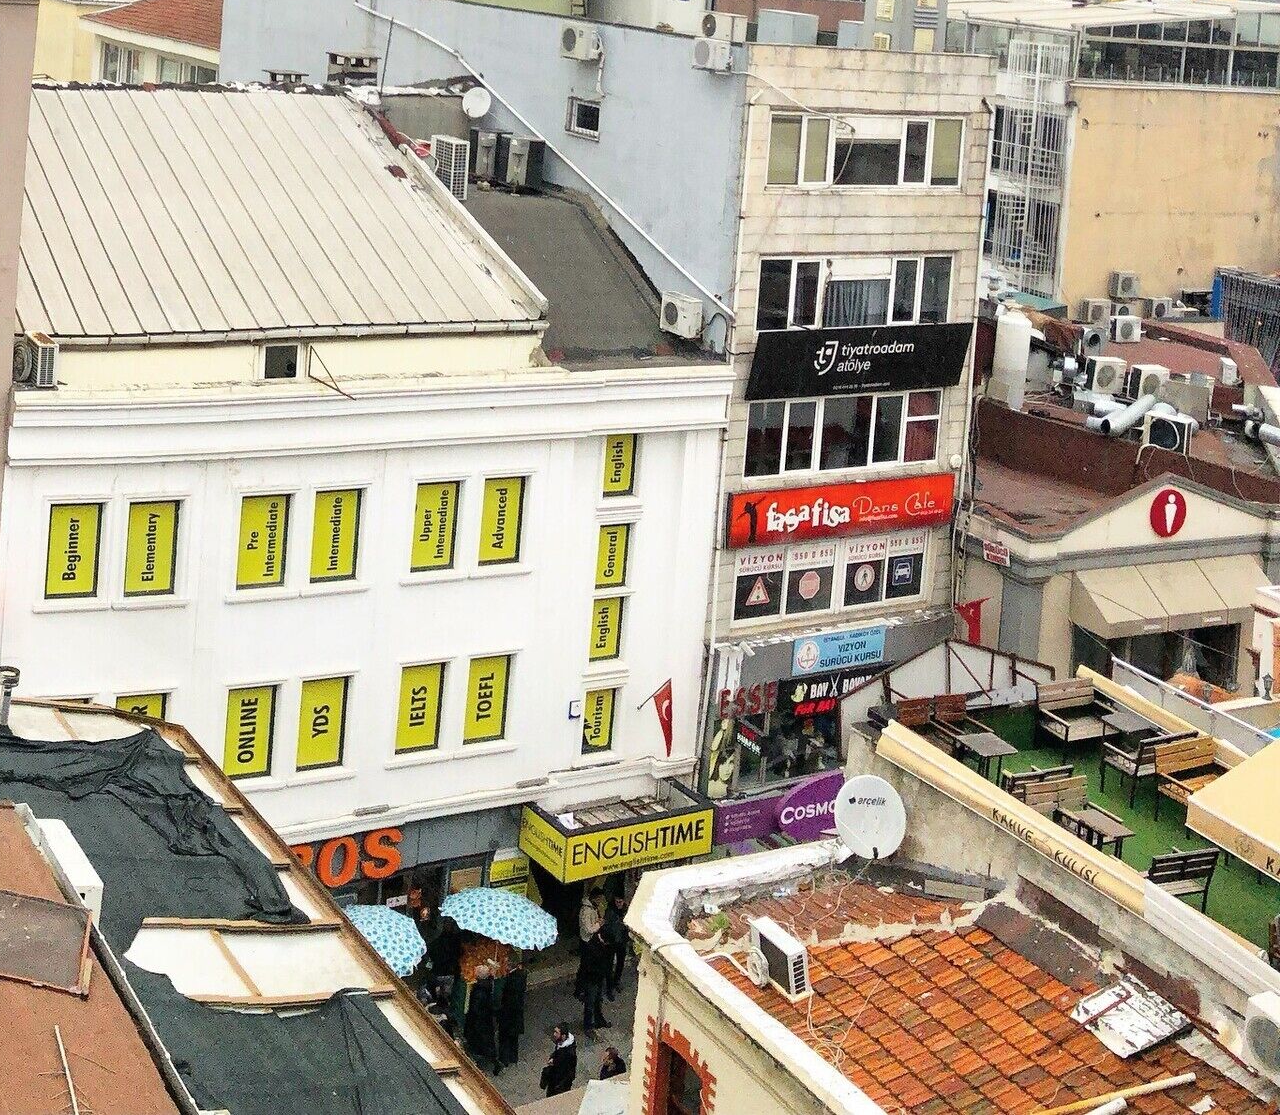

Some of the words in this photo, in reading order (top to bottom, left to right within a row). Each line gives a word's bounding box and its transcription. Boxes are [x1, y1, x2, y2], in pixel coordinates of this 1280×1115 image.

[836, 359, 871, 374] atölye
[841, 339, 915, 357] tiyatroadam
[610, 441, 625, 484] English
[420, 508, 433, 542] Upper
[433, 489, 450, 559] Intermediate
[491, 487, 509, 549] Advanced
[852, 495, 899, 515] Dans
[904, 491, 936, 516] Cafe
[61, 517, 81, 581] Beginner
[141, 512, 161, 582] Elementary
[246, 531, 260, 551] Pre
[262, 501, 279, 577] Intermediate
[326, 496, 343, 571] Intermediate
[603, 530, 618, 578] General
[596, 606, 611, 649] English
[854, 649, 882, 663] KURSU
[409, 685, 428, 727] IELTS
[476, 672, 495, 723] TOEFL
[590, 695, 604, 741] Tourism
[236, 696, 259, 764] ONLINE
[311, 704, 330, 738] YDS
[857, 795, 887, 807] arçelik
[571, 818, 705, 866] ENGLISHTIME
[992, 807, 1034, 843] KAHVE
